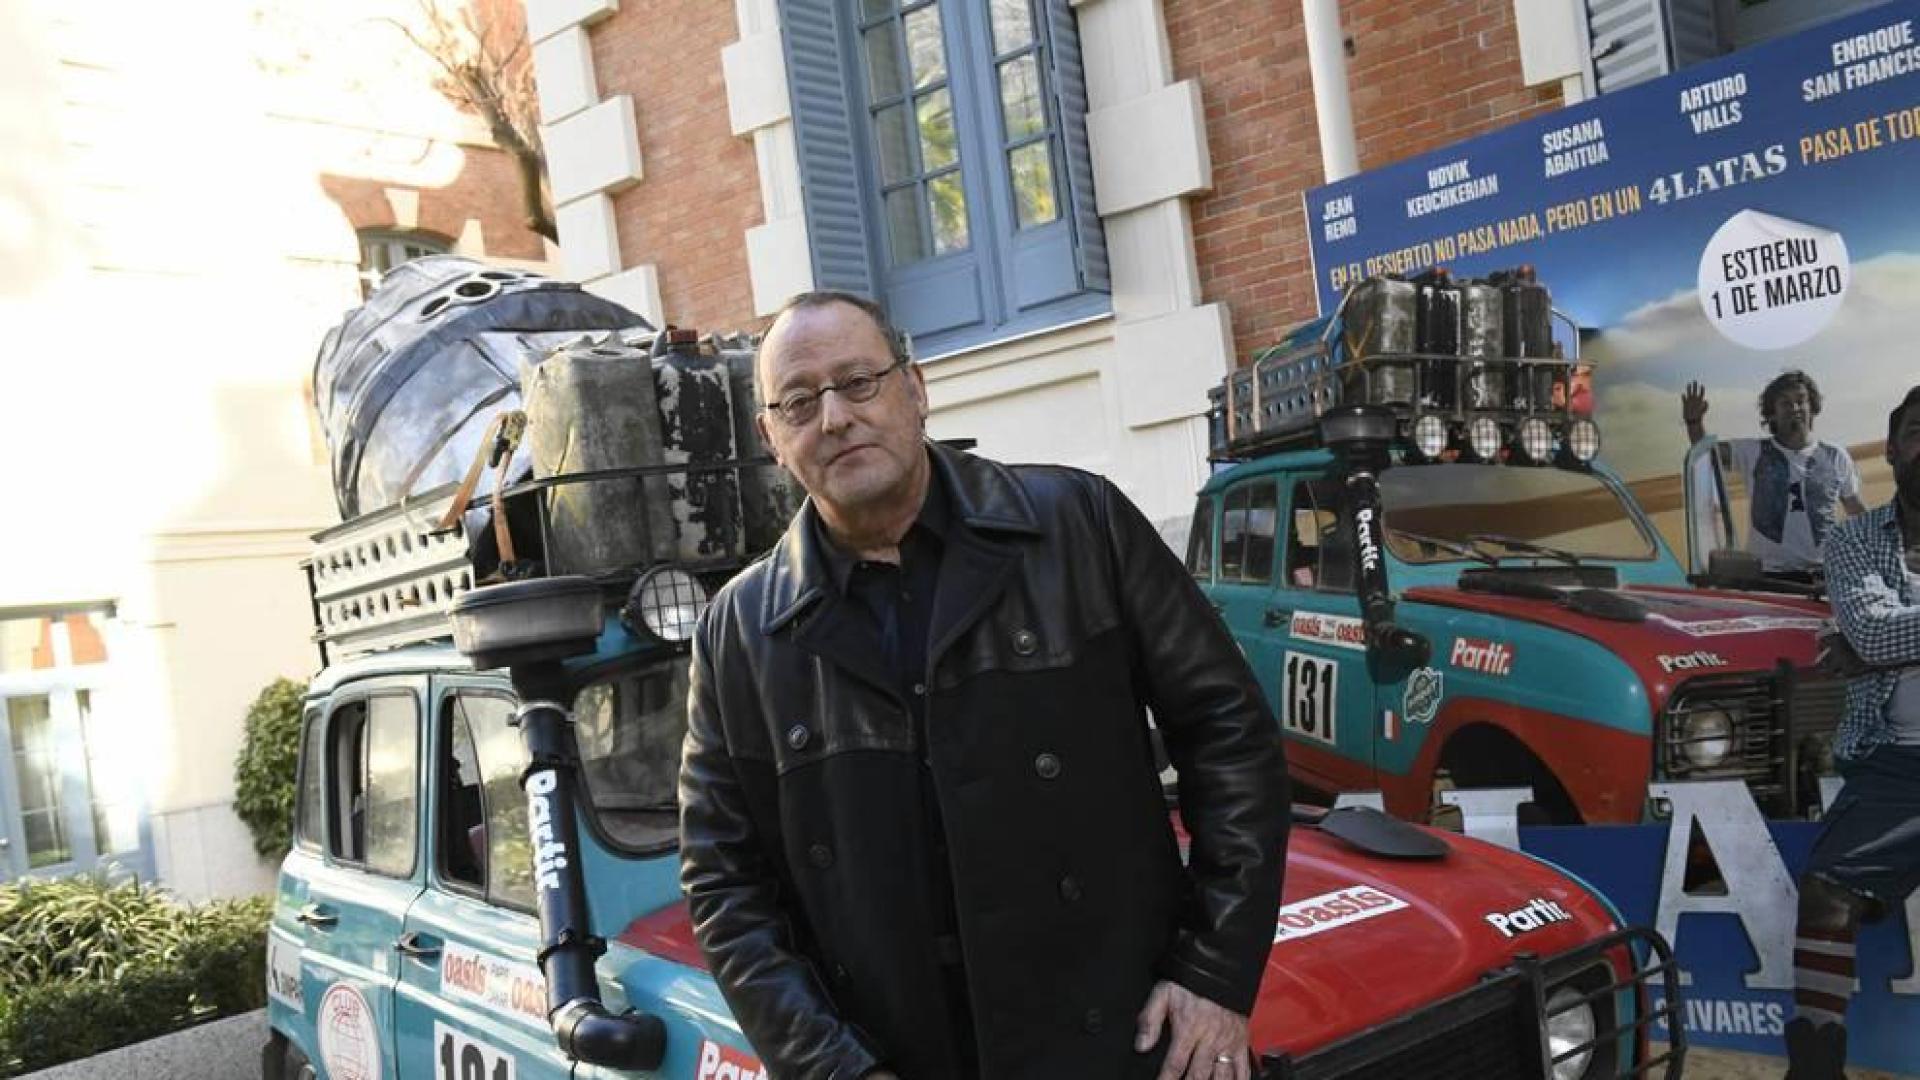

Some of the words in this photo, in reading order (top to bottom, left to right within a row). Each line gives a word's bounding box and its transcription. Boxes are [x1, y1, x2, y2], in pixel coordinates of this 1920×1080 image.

[1832, 20, 1914, 65] ENRIQUE
[1680, 73, 1747, 113] ARTURO
[1802, 70, 1841, 102] SAN
[1542, 118, 1604, 153] SUSANA
[1690, 101, 1742, 134] VALLS
[1428, 159, 1470, 189] HOVIK
[1545, 141, 1609, 178] ABAITUA
[1323, 195, 1354, 221] JEAN
[1330, 265, 1349, 291] EN
[1366, 243, 1433, 277] DESIERTO
[1434, 236, 1456, 263] NO
[1457, 224, 1497, 257] PASA
[1498, 212, 1545, 247] NADA,
[1546, 200, 1589, 233] PERO
[1591, 191, 1613, 222] EN
[1615, 185, 1642, 215] UN
[1647, 144, 1787, 205] 4LATAS
[1800, 127, 1853, 166] PASA
[1855, 117, 1883, 151] DE
[1407, 174, 1498, 218] KEUCHKERIAN
[1325, 216, 1357, 243] RENO
[1721, 237, 1818, 282] ESTRENU
[1711, 290, 1723, 319] 1
[1731, 283, 1759, 315] DE
[1764, 265, 1842, 309] MARZO
[1288, 656, 1333, 740] 131
